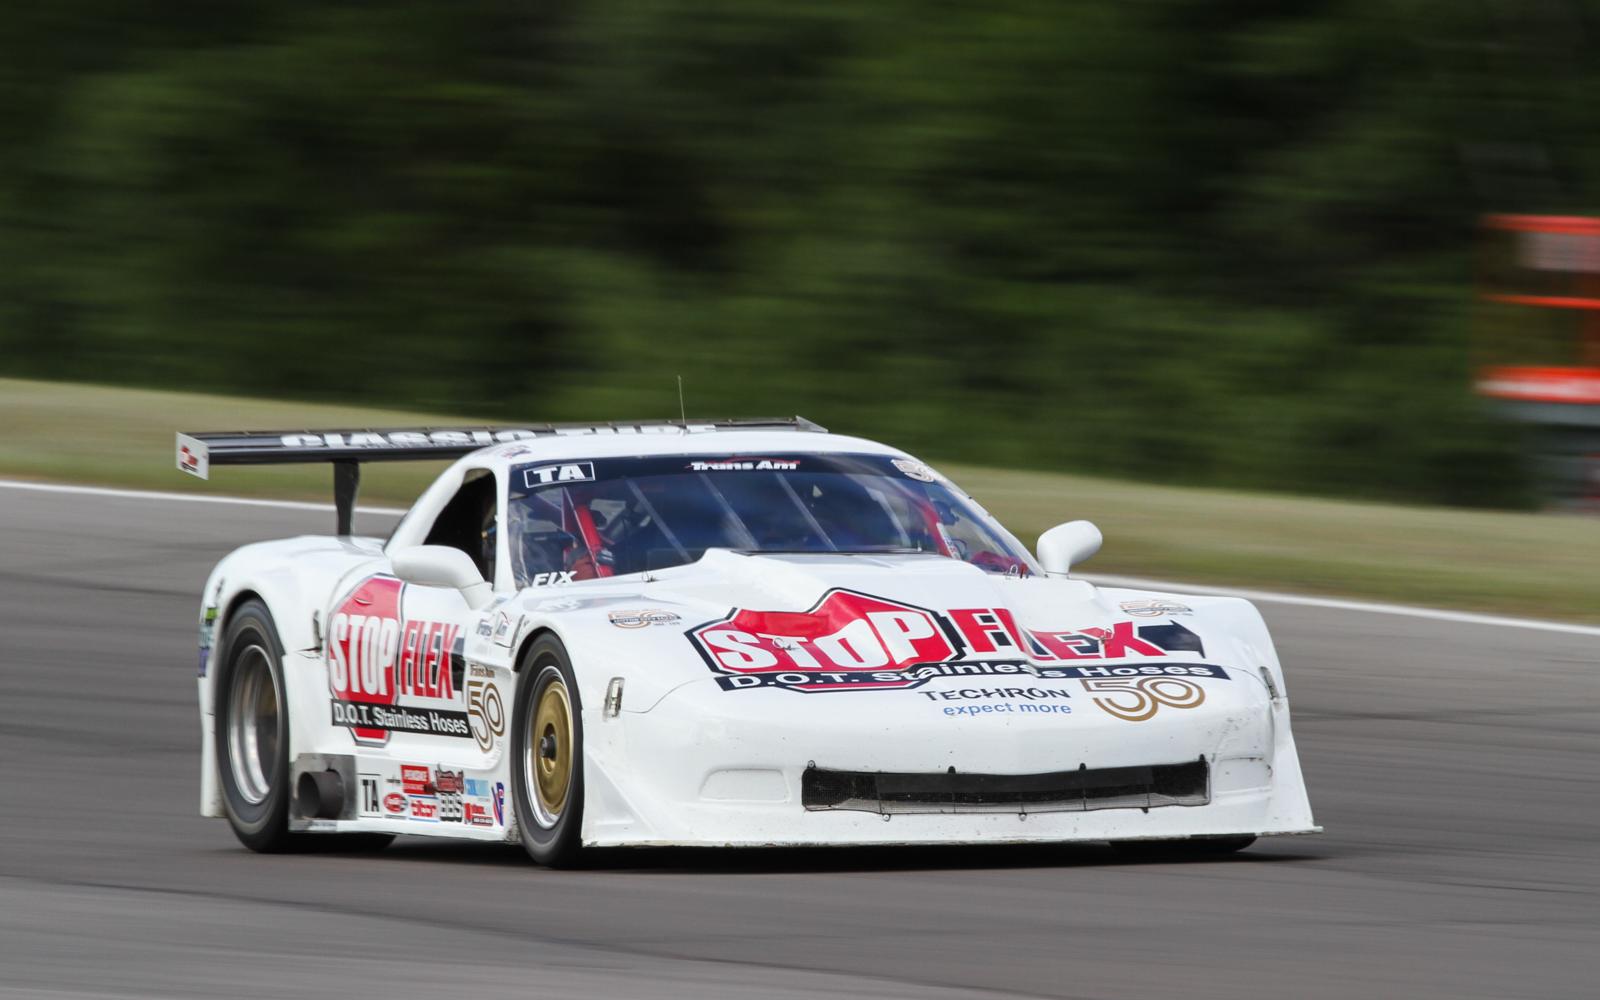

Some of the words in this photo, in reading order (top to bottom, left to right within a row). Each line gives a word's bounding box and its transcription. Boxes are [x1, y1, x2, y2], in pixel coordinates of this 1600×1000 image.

[281, 430, 537, 448] CLASSIC
[533, 464, 586, 484] TA
[691, 461, 752, 471] Trans
[755, 460, 797, 470] Am
[532, 571, 578, 587] FIX
[702, 610, 935, 669] STOP
[945, 607, 1168, 661] FLEX
[329, 613, 400, 696] STOP
[400, 619, 460, 700] FLEX
[729, 672, 860, 689] D.O.T.
[870, 662, 1067, 682] Stainless
[1077, 664, 1214, 679] Hoses
[917, 687, 1072, 701] TECHRON
[1080, 676, 1206, 722] 50
[333, 702, 373, 727] D.O.T.
[373, 704, 430, 731] Stainless
[429, 710, 469, 735] Hoses
[467, 680, 506, 752] 50
[943, 703, 1013, 717] expect
[1019, 703, 1073, 715] more
[362, 779, 380, 812] TA
